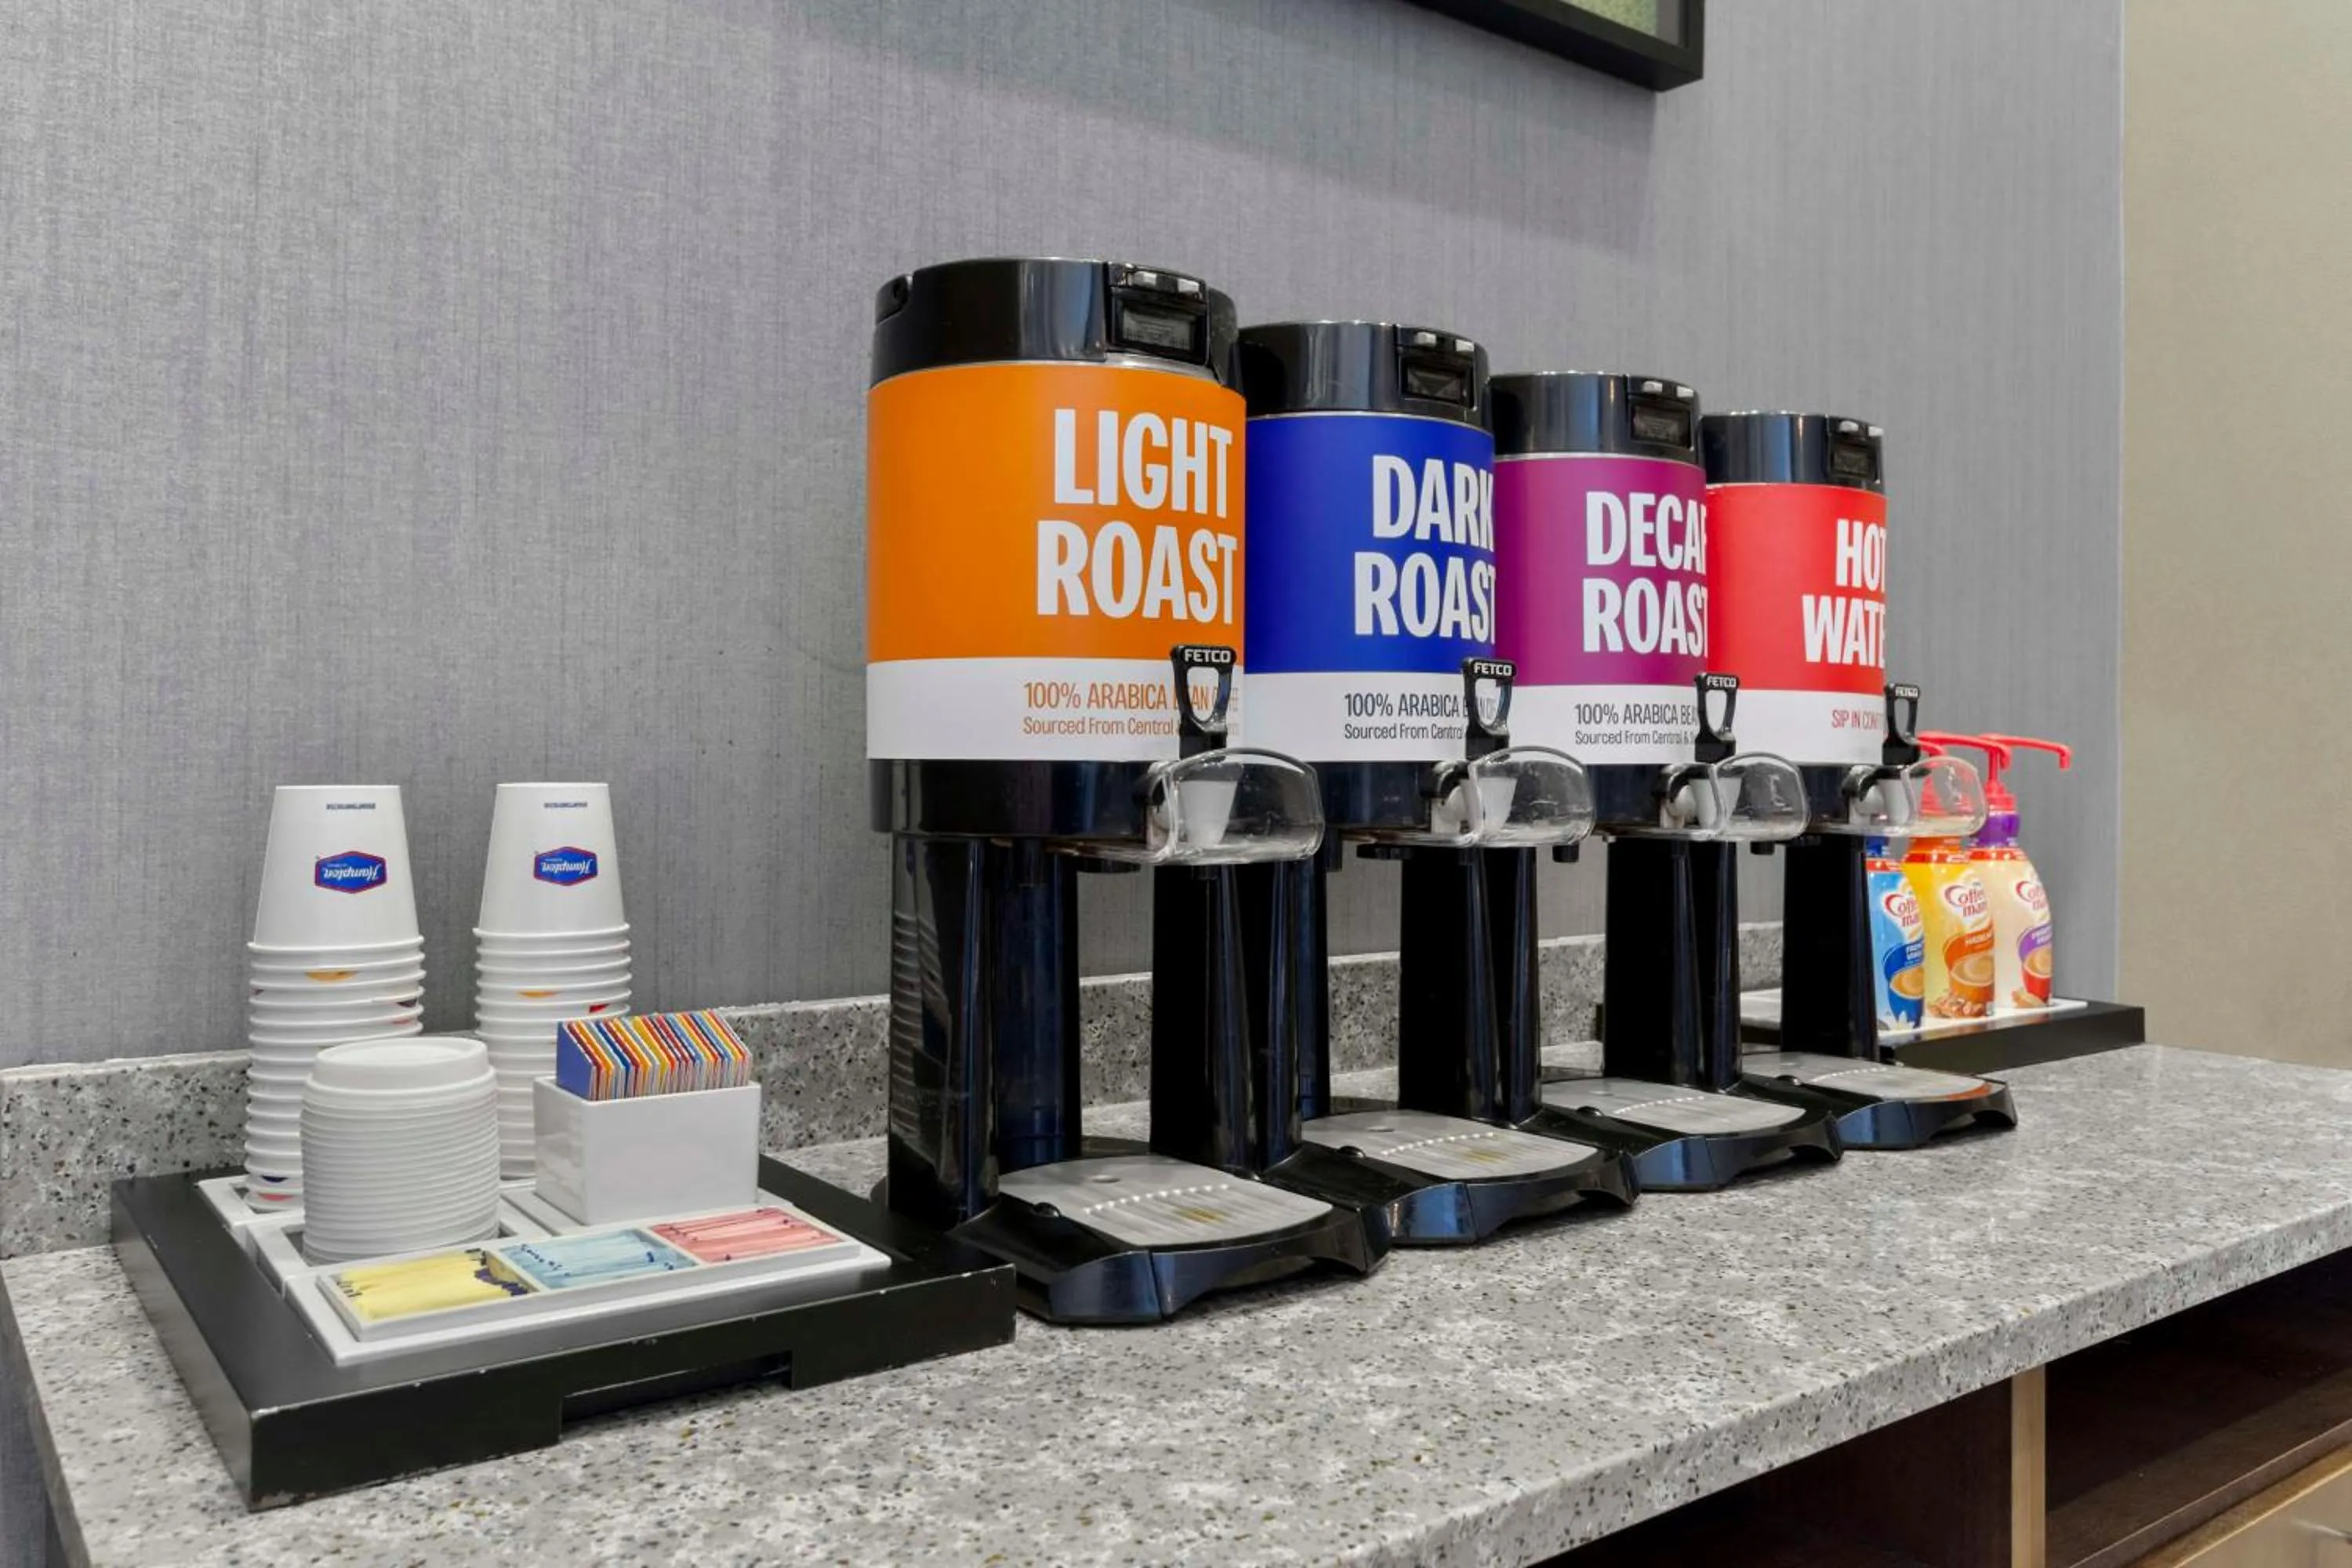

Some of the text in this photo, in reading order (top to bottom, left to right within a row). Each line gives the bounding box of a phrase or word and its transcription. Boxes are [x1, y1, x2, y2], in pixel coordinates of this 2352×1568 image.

[1054, 408, 1233, 519] LIGHT
[1373, 454, 1494, 553] DARK
[1835, 518, 1887, 593] HOT
[1036, 520, 1238, 625] ROAST
[1354, 551, 1496, 646] ROAST
[1583, 577, 1708, 659] ROAST
[1802, 593, 1886, 670] WATE
[1184, 648, 1232, 663] FETCO
[1474, 662, 1512, 677] FETCO
[1706, 675, 1737, 688] FETCO
[1023, 681, 1081, 710] 100%
[1086, 681, 1168, 710] ARABICA
[1345, 692, 1393, 717] 100%
[1397, 693, 1459, 718] ARABICA
[1574, 703, 1619, 724] 100%
[1623, 704, 1678, 725] ARABICA
[1831, 709, 1849, 728] SIP
[1851, 710, 1860, 728] IN
[1023, 716, 1086, 735] Sourced
[1088, 717, 1125, 735] From
[1127, 717, 1174, 735] Central
[1345, 723, 1397, 739] Sourced
[1399, 724, 1429, 739] From
[1574, 729, 1622, 746] Sourced
[1624, 731, 1650, 745] From
[321, 863, 383, 882] Hampton
[540, 858, 595, 876] Hampton
